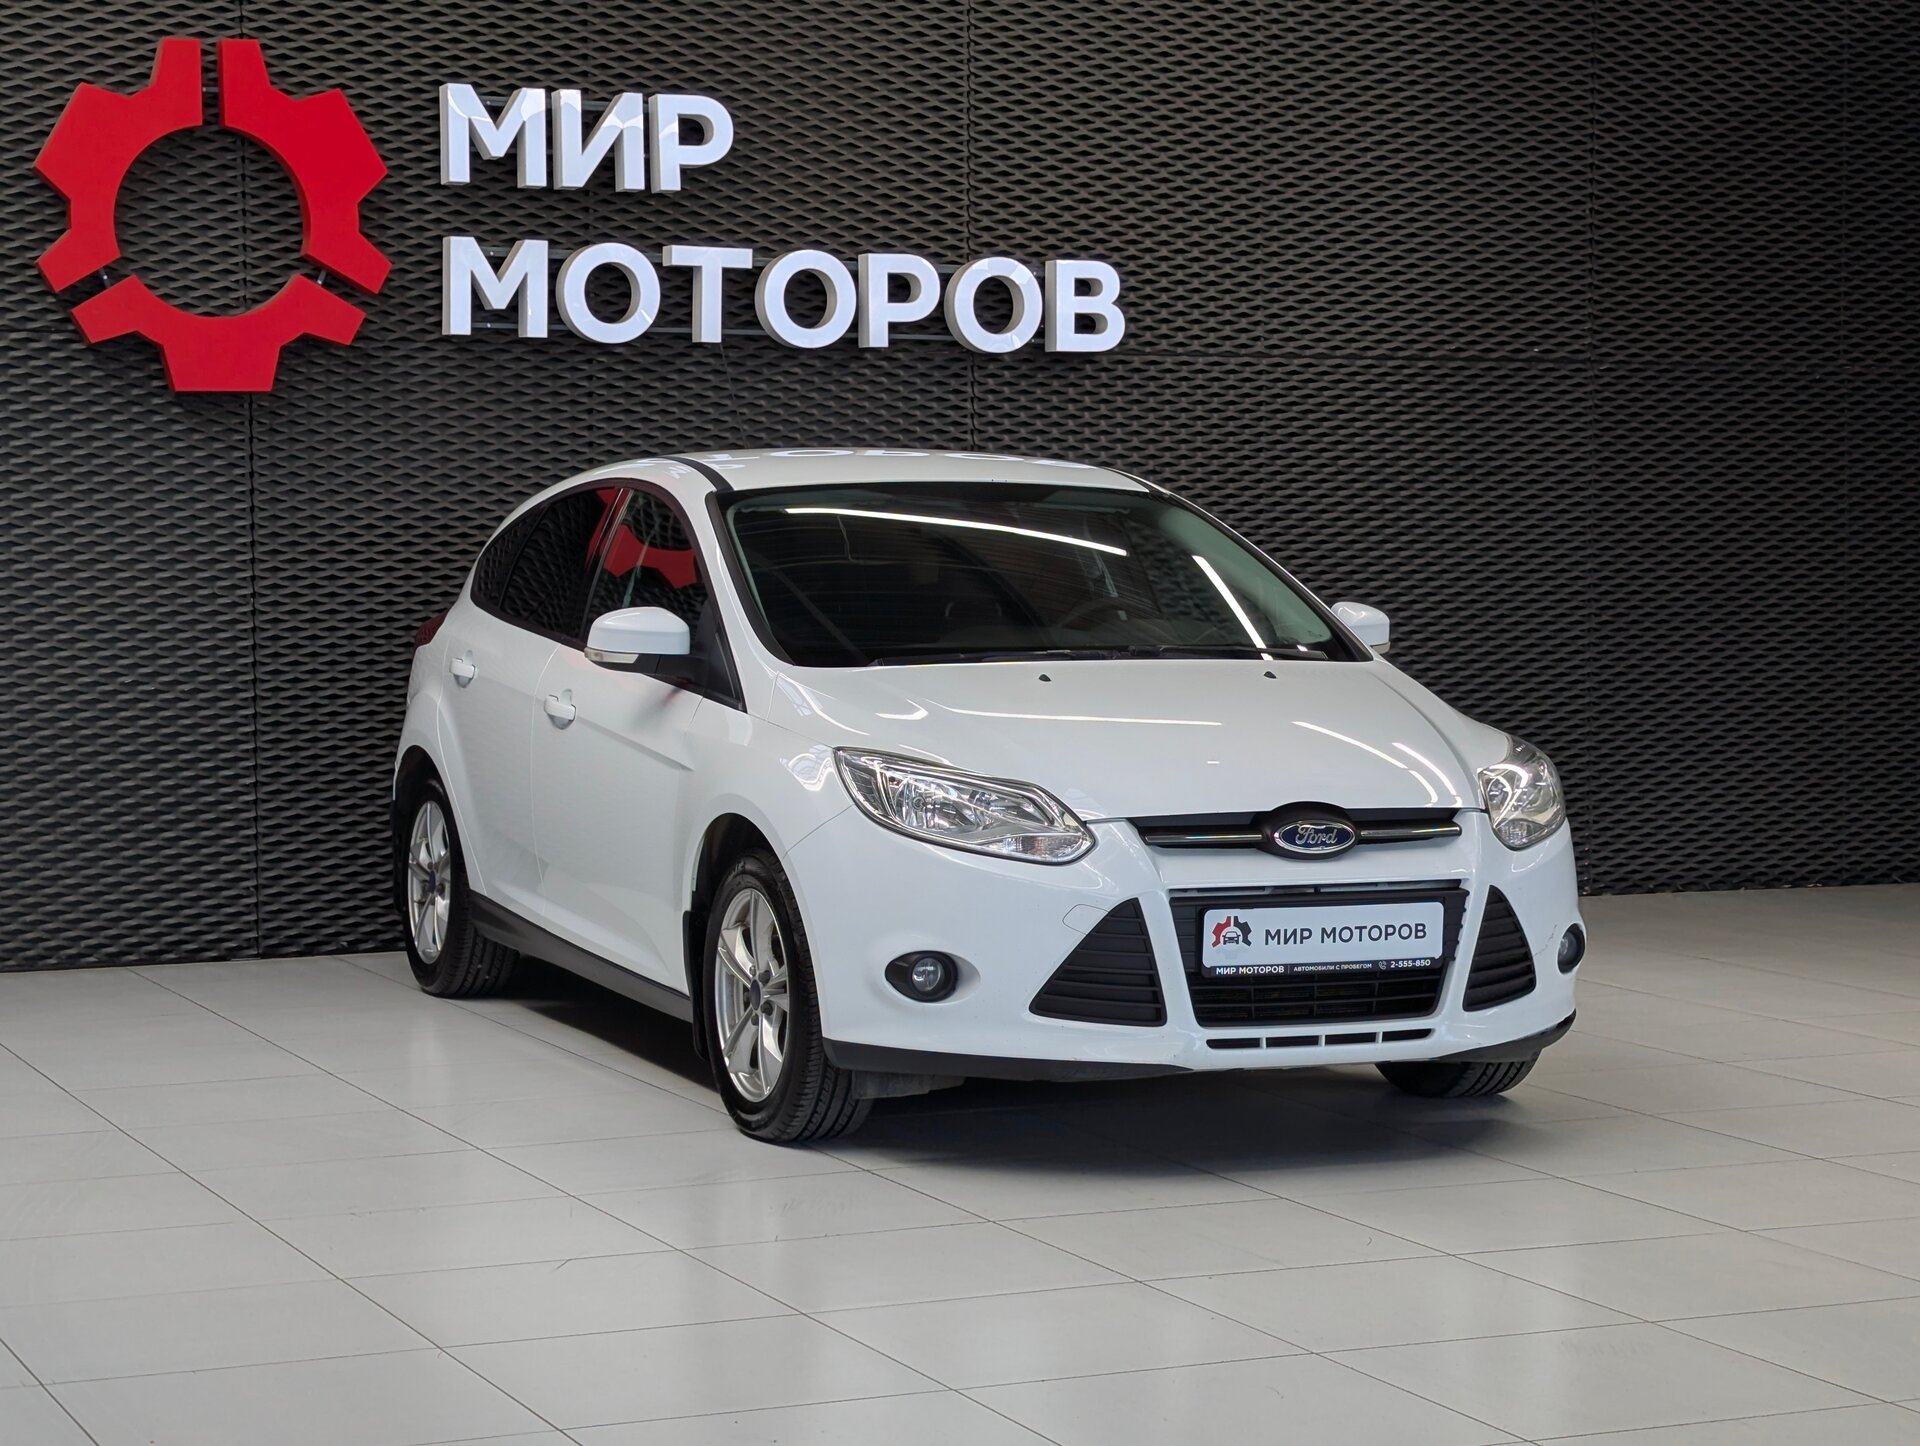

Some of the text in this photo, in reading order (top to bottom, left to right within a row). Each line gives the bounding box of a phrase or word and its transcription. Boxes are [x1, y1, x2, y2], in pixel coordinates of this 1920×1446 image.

[439, 82, 734, 194] МИР
[442, 235, 1126, 354] МОТОРОВ
[1295, 824, 1338, 845] Ford
[1264, 922, 1427, 946] МИР МОТОРОВ
[1216, 966, 1237, 975] МИР
[1238, 965, 1285, 975] МОТОРОВ
[1293, 964, 1335, 972] АВТОМОБИЛИ
[1390, 959, 1431, 968] 2-555-850
